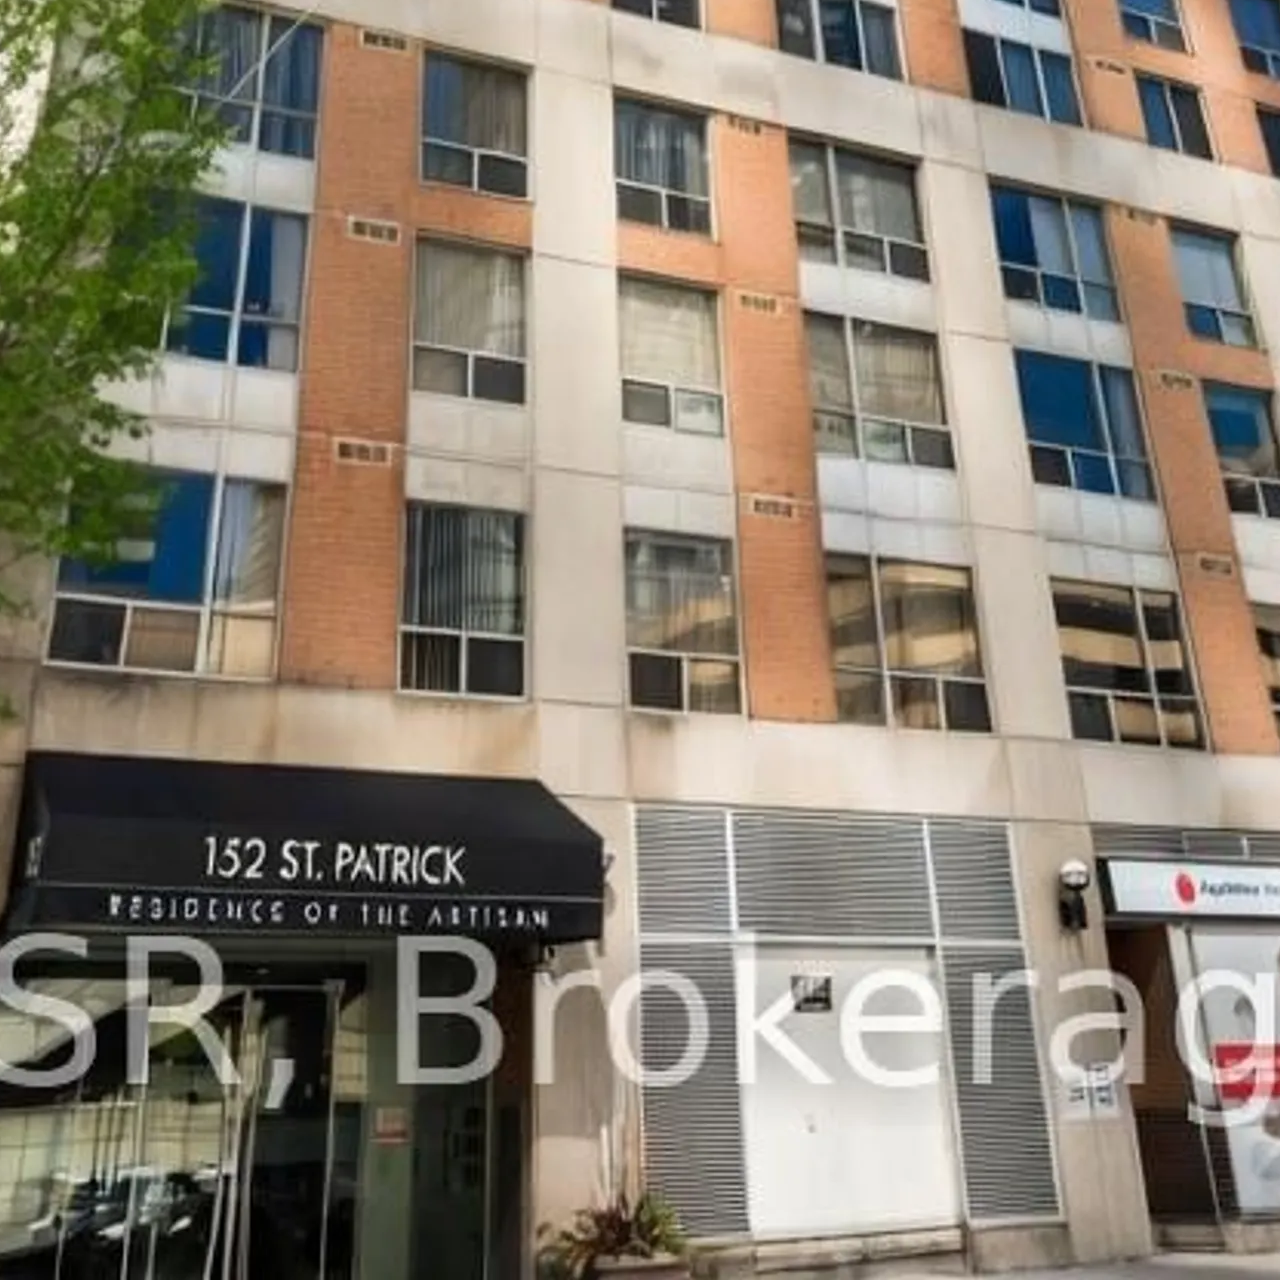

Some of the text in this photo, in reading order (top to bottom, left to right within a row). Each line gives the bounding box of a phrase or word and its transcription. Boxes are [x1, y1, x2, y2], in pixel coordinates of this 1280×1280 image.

[205, 836, 467, 886] 152 ST. PATRICK
[109, 893, 285, 923] RESIDENCE
[361, 901, 410, 928] THE
